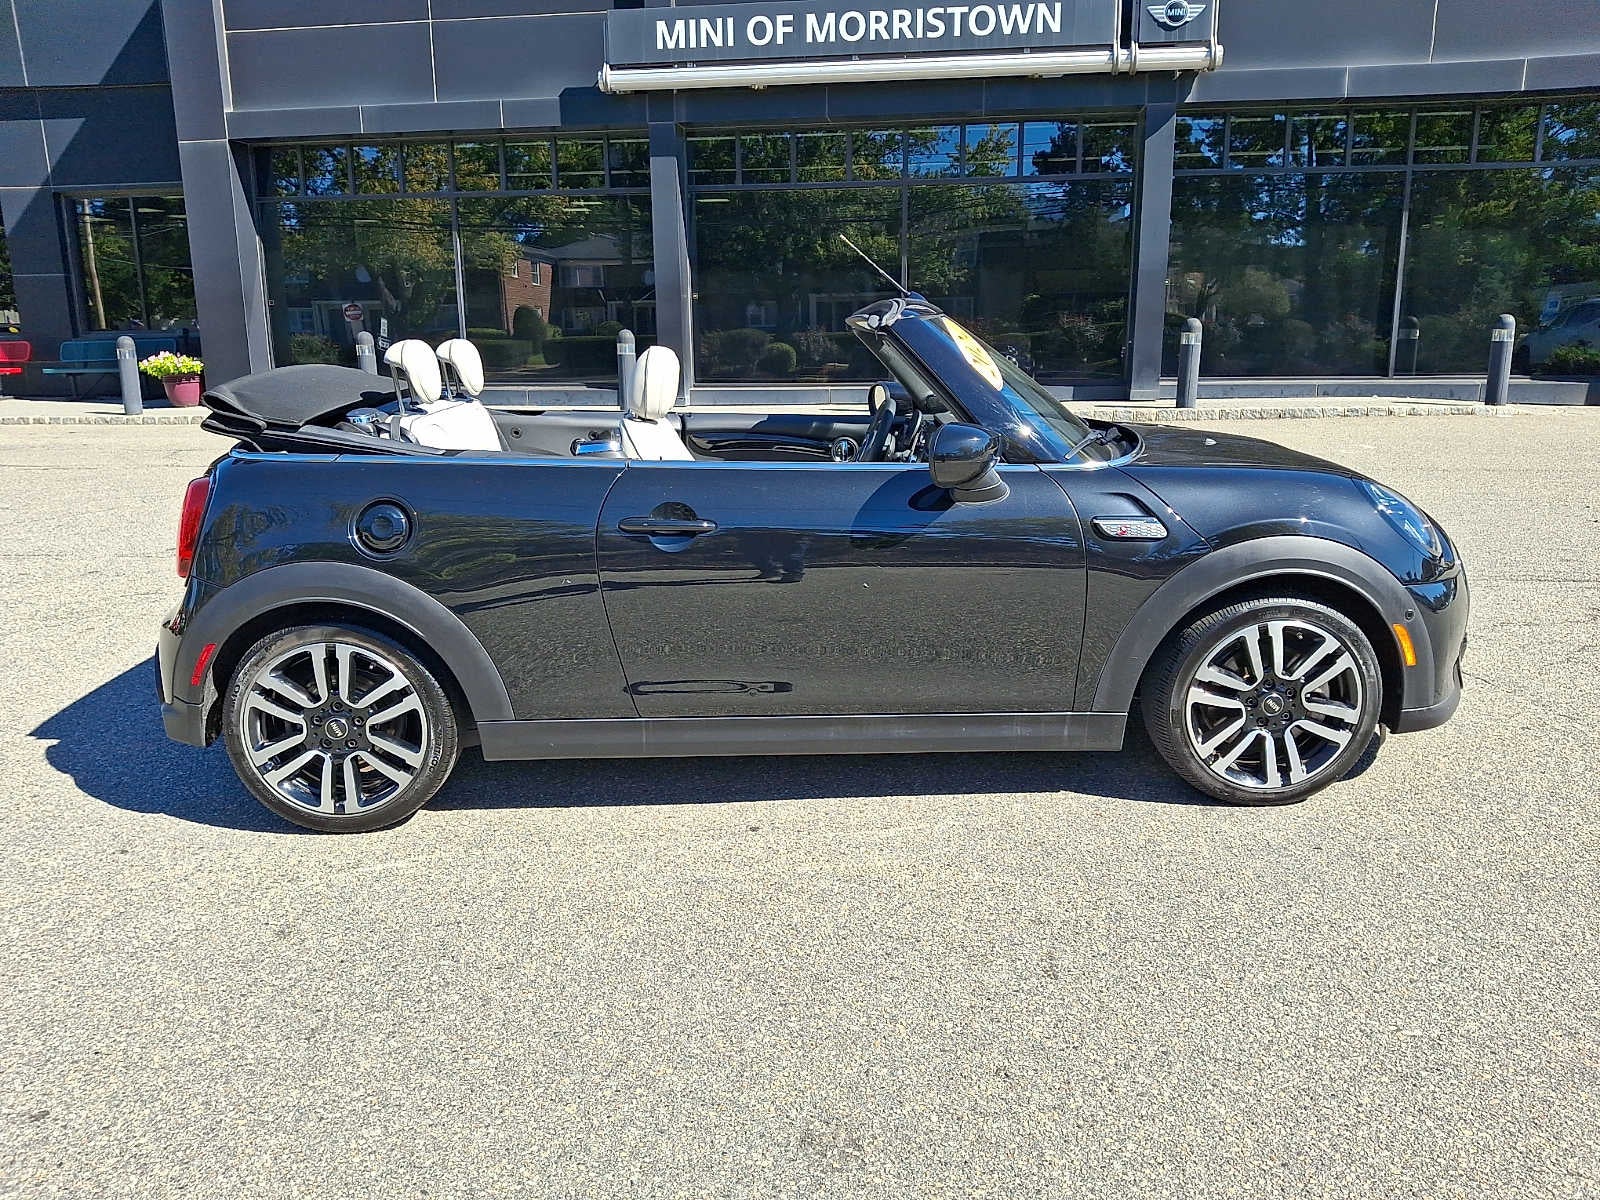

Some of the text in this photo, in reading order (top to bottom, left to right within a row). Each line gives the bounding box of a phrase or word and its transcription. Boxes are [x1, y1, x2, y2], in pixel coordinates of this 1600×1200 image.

[656, 2, 1063, 50] MINI OF MORRISTOWN
[1167, 8, 1186, 16] MINI
